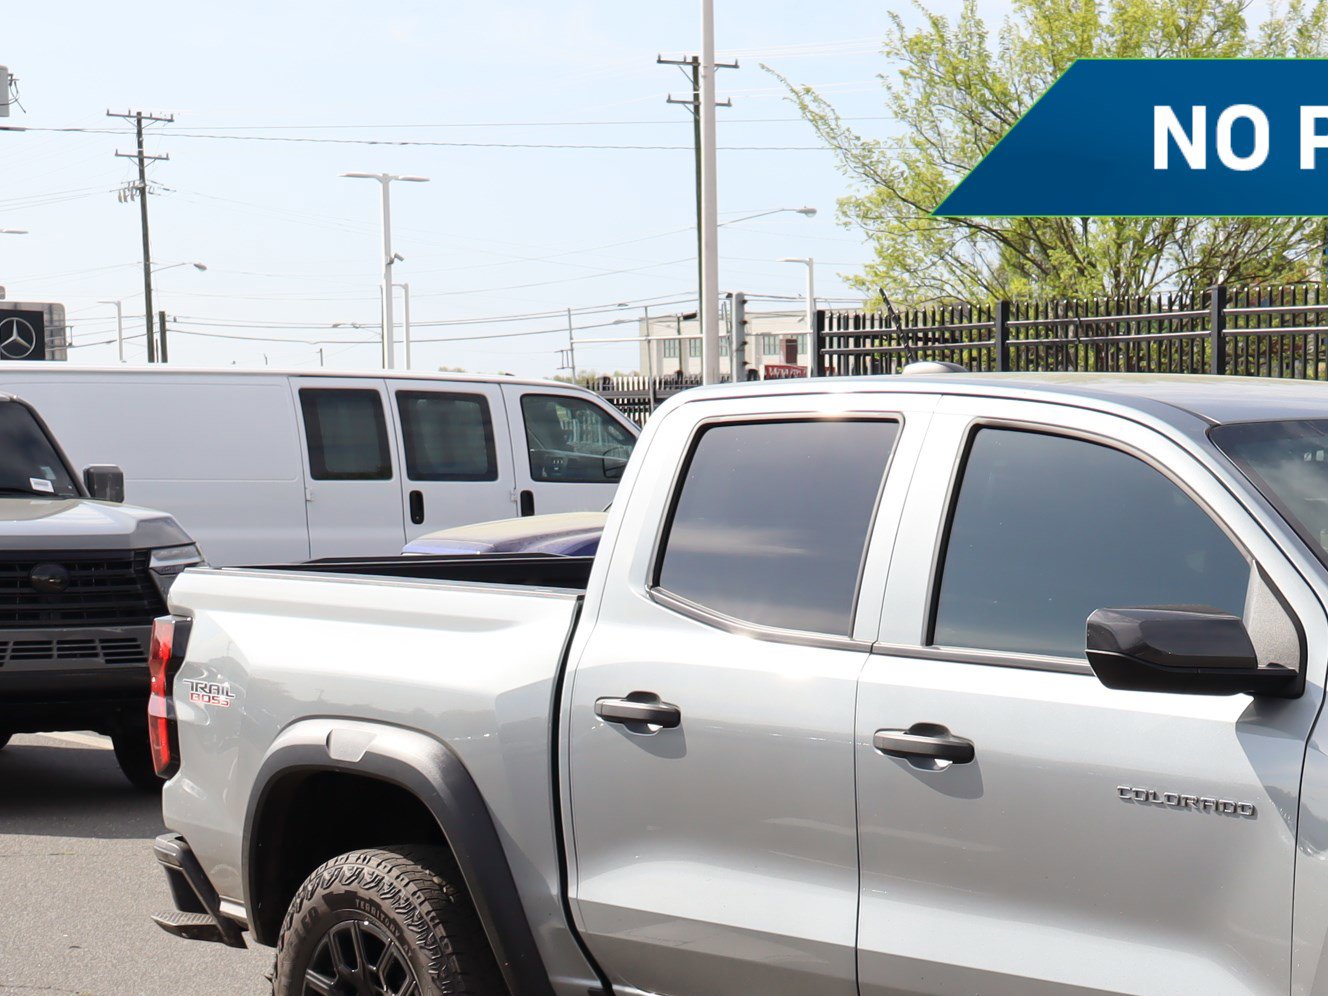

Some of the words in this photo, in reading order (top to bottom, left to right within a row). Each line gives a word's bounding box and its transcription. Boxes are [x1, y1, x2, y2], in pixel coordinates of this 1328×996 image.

[183, 679, 235, 699] TRAIL
[190, 692, 230, 708] BOSS
[1117, 784, 1258, 818] COLORADO
